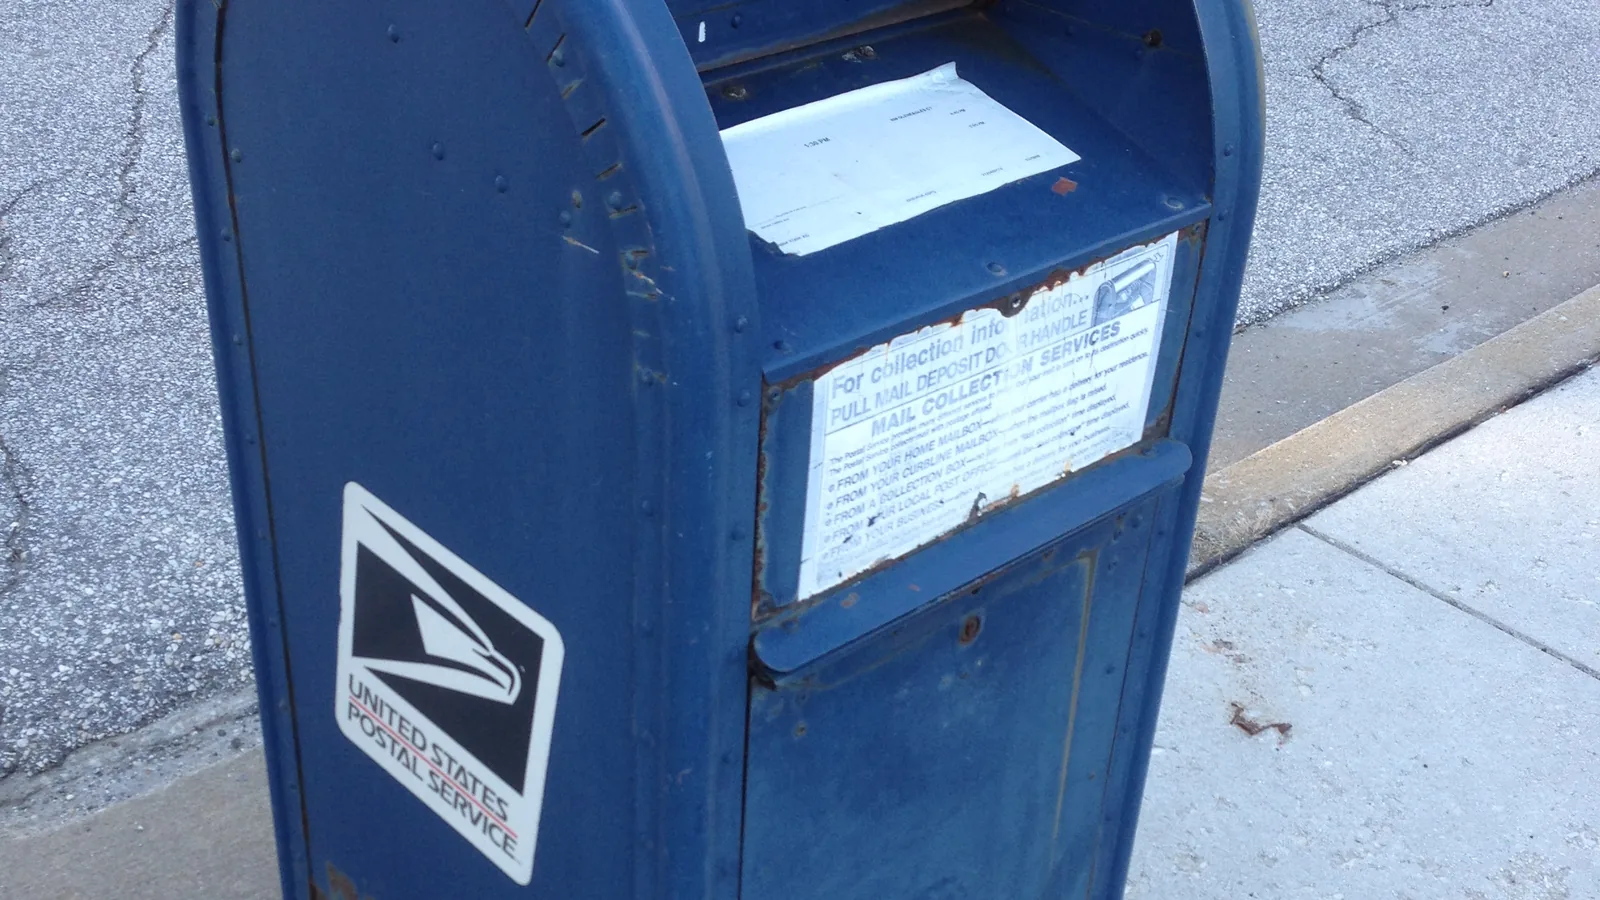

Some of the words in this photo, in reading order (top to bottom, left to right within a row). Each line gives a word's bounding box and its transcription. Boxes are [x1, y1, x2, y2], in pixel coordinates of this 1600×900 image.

[830, 395, 872, 424] PULL
[874, 379, 914, 406] MAIL
[915, 352, 983, 390] DEPOSIT
[984, 334, 1028, 362] DOR
[1028, 309, 1088, 344] HANDLE
[831, 372, 864, 398] For
[871, 333, 965, 385] collection
[870, 406, 916, 435] MAIL
[1039, 321, 1122, 366] SERVICES
[835, 485, 867, 507] FROM
[869, 472, 899, 491] YOUR
[836, 468, 868, 489] FROM
[871, 455, 901, 474] YOUR
[903, 440, 935, 460] HOME
[833, 503, 865, 523] FROM
[868, 496, 879, 508] A
[347, 701, 423, 781] POSTAL
[427, 767, 518, 864] SERVICE
[348, 673, 427, 753] UNITED
[430, 741, 510, 823] STATES
